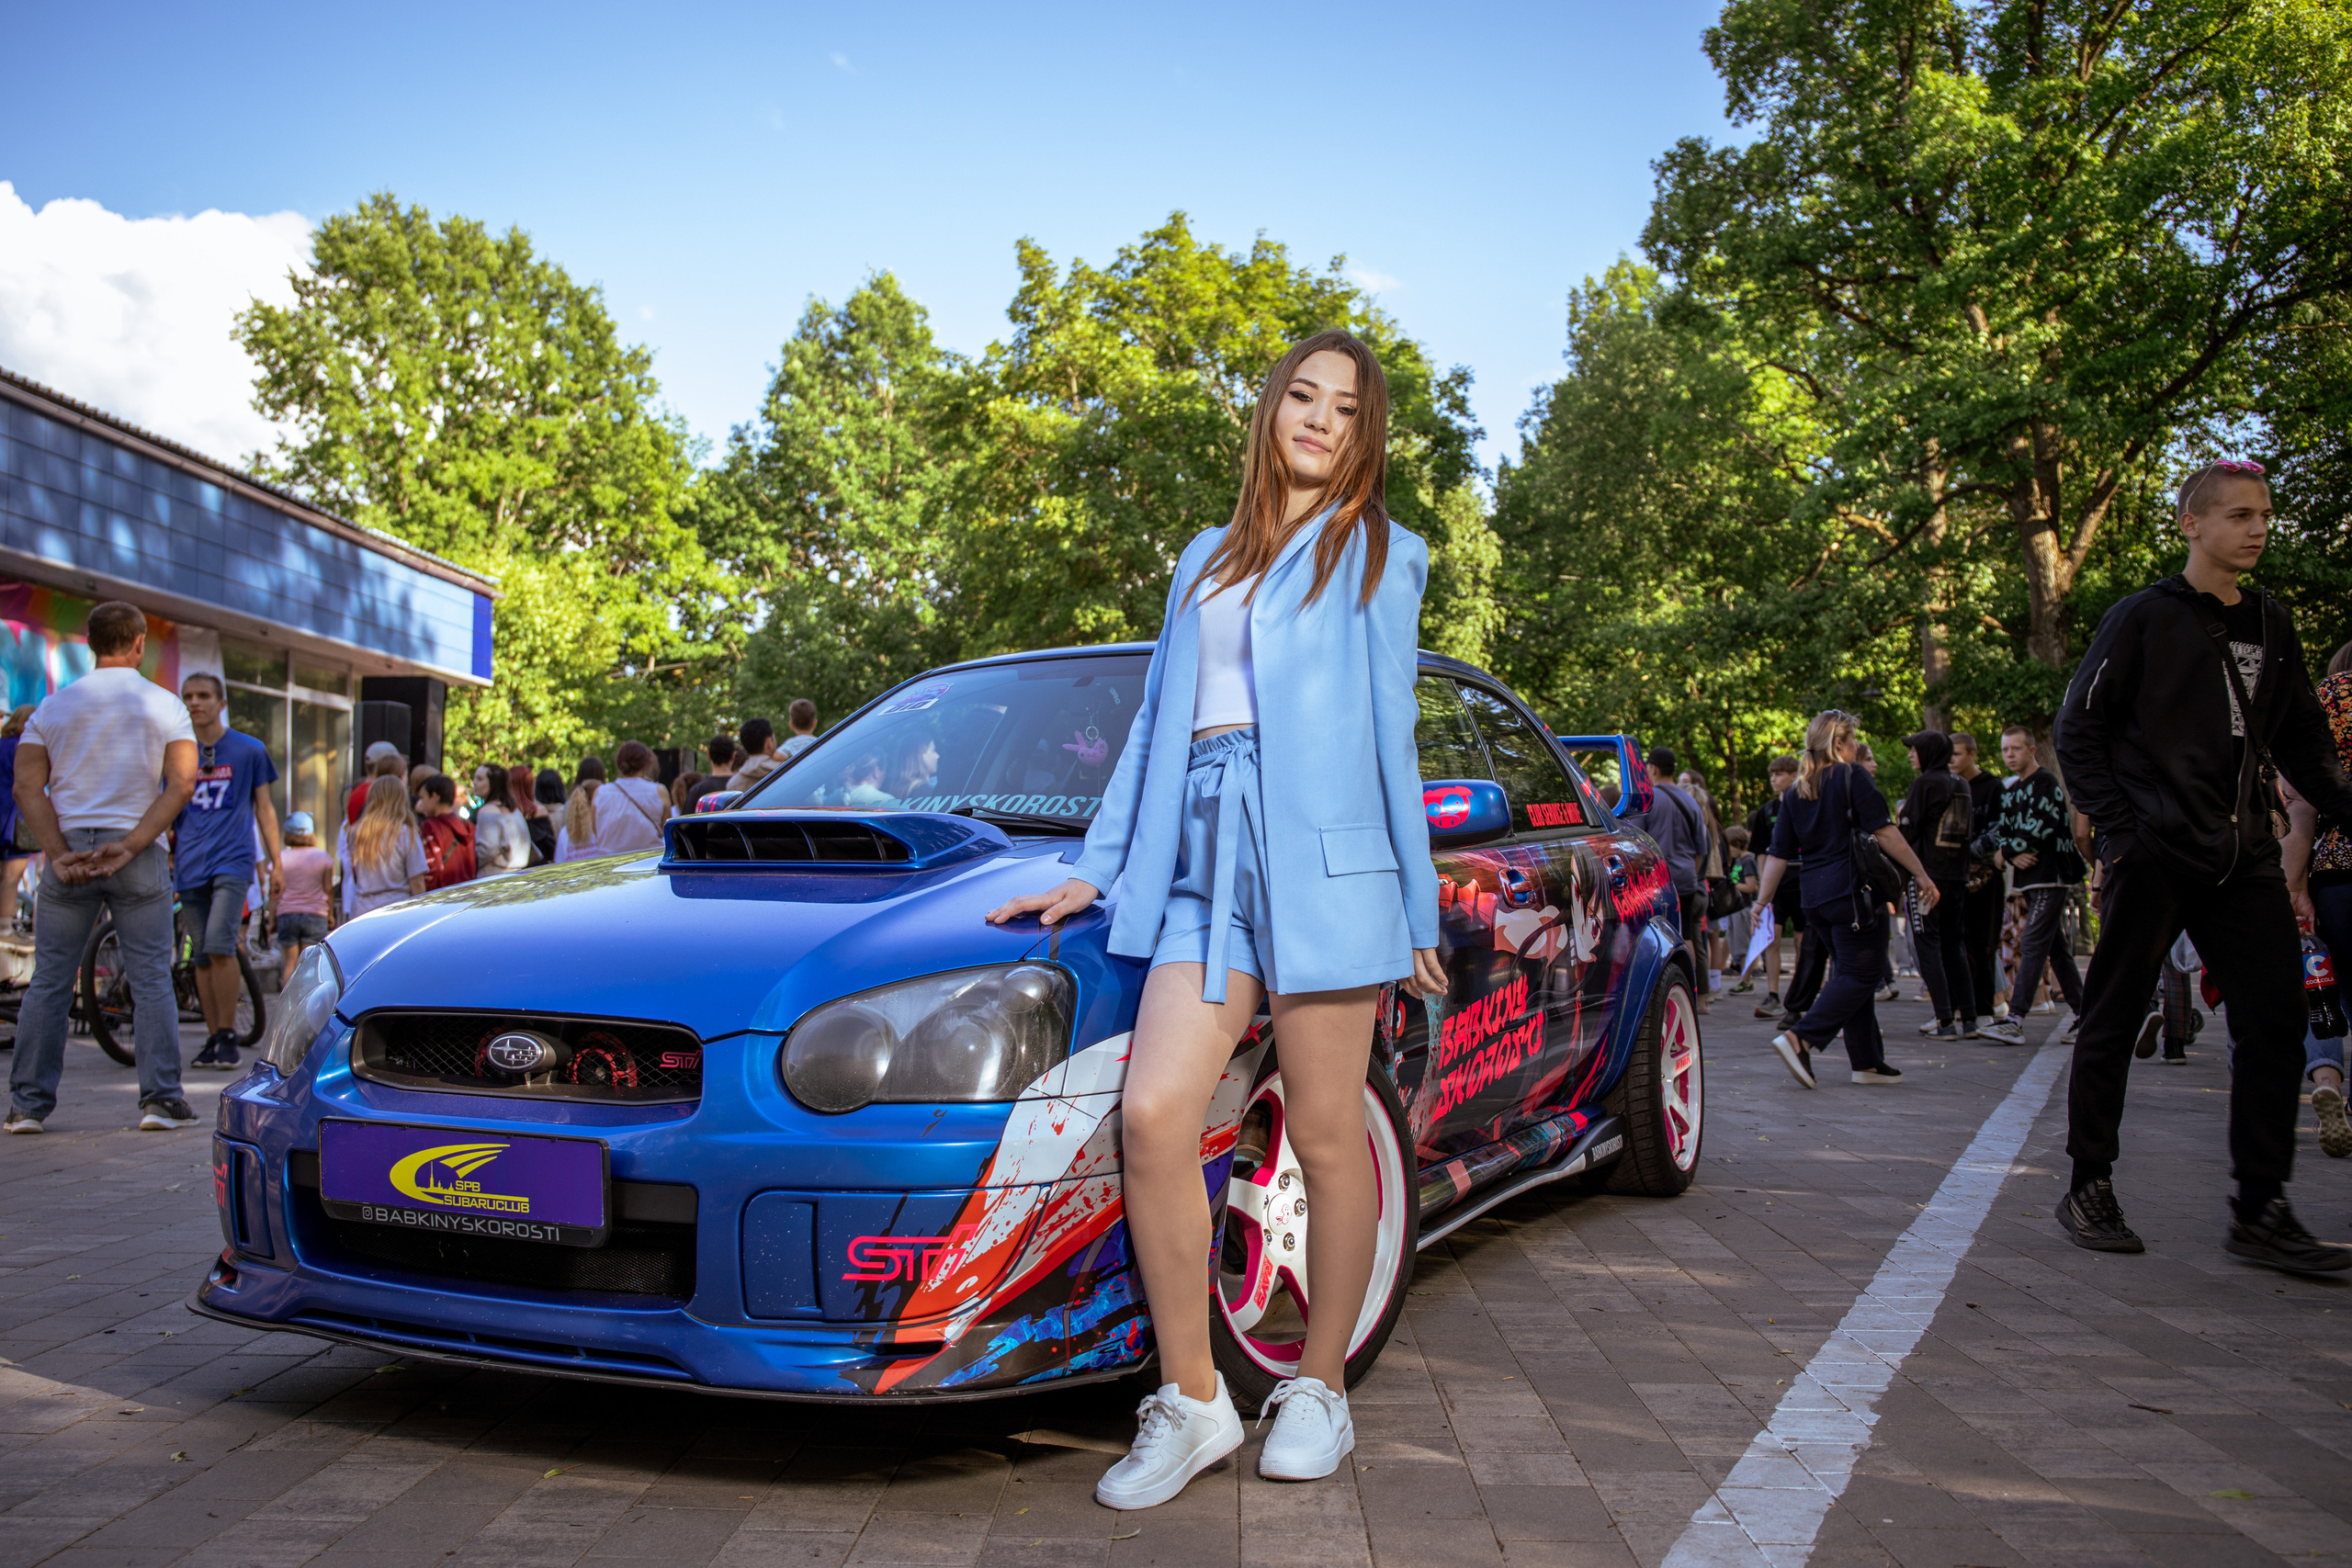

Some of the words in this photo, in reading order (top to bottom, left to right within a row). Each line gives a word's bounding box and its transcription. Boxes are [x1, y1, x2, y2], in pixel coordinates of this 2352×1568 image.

[191, 780, 231, 809] 47
[1526, 804, 1545, 827] CLUB
[1438, 974, 1529, 1071] BABKINY
[455, 1179, 481, 1192] SPB
[444, 1195, 530, 1213] SUBARUCLUB
[376, 1209, 560, 1241] BABKINYSKOROSTI
[1256, 1257, 1273, 1312] RAYS
